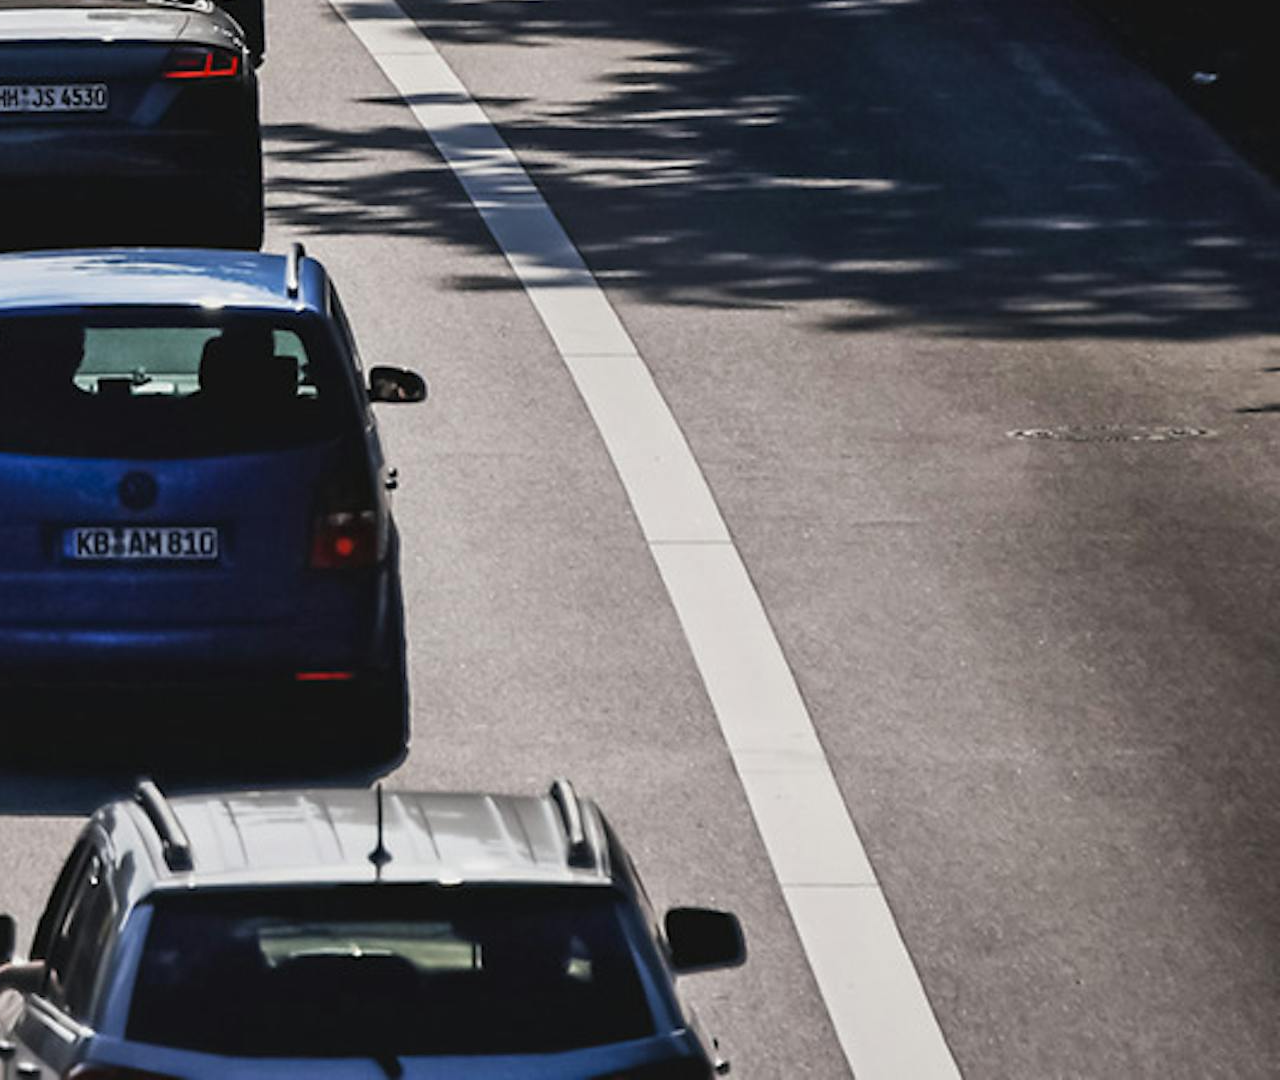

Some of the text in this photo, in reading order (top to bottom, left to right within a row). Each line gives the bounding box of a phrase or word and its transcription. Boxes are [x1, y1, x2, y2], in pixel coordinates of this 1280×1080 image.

[32, 88, 55, 107] JS
[61, 87, 105, 106] 4530
[77, 531, 214, 555] KB AM 810
